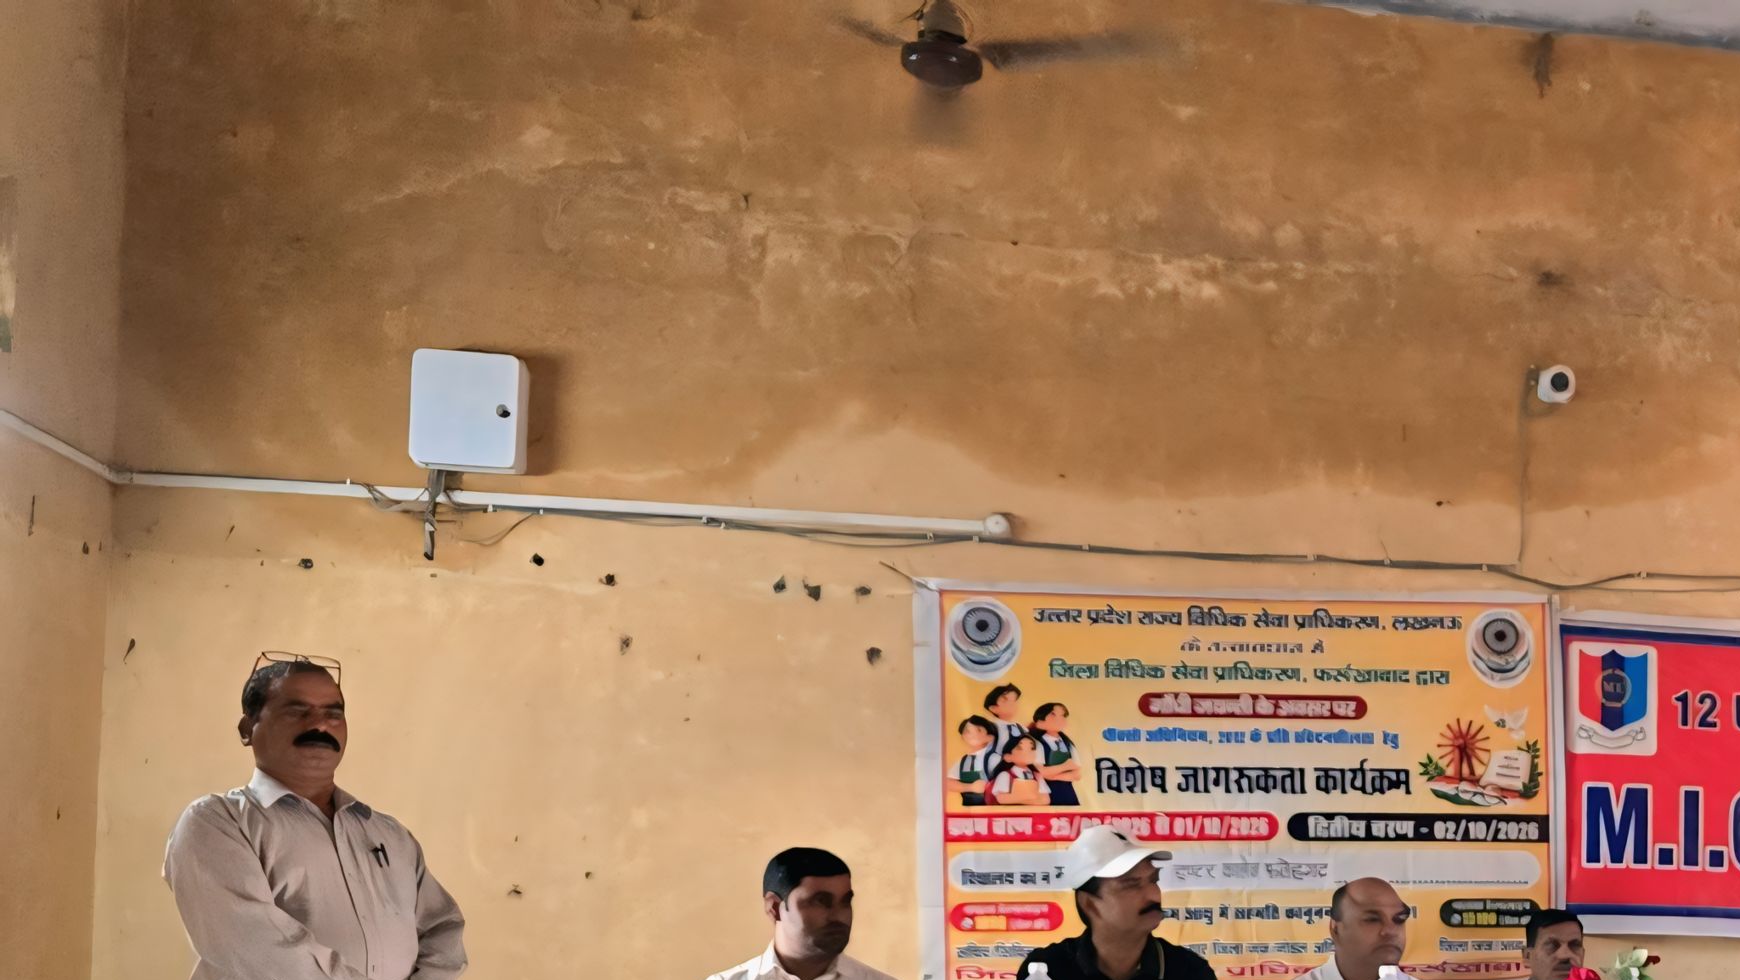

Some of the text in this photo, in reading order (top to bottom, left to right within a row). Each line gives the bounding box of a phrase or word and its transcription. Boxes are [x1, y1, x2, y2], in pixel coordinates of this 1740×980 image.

[1033, 608, 1082, 623] उत्तर
[1087, 604, 1131, 625] प्रदेश
[1187, 605, 1248, 626] विधिक
[1673, 689, 1720, 731] 12
[1095, 757, 1168, 793] विशेष
[1314, 758, 1412, 795] कार्यक्रम
[1370, 820, 1416, 838] चरण
[1433, 819, 1539, 841] 02/10/2026
